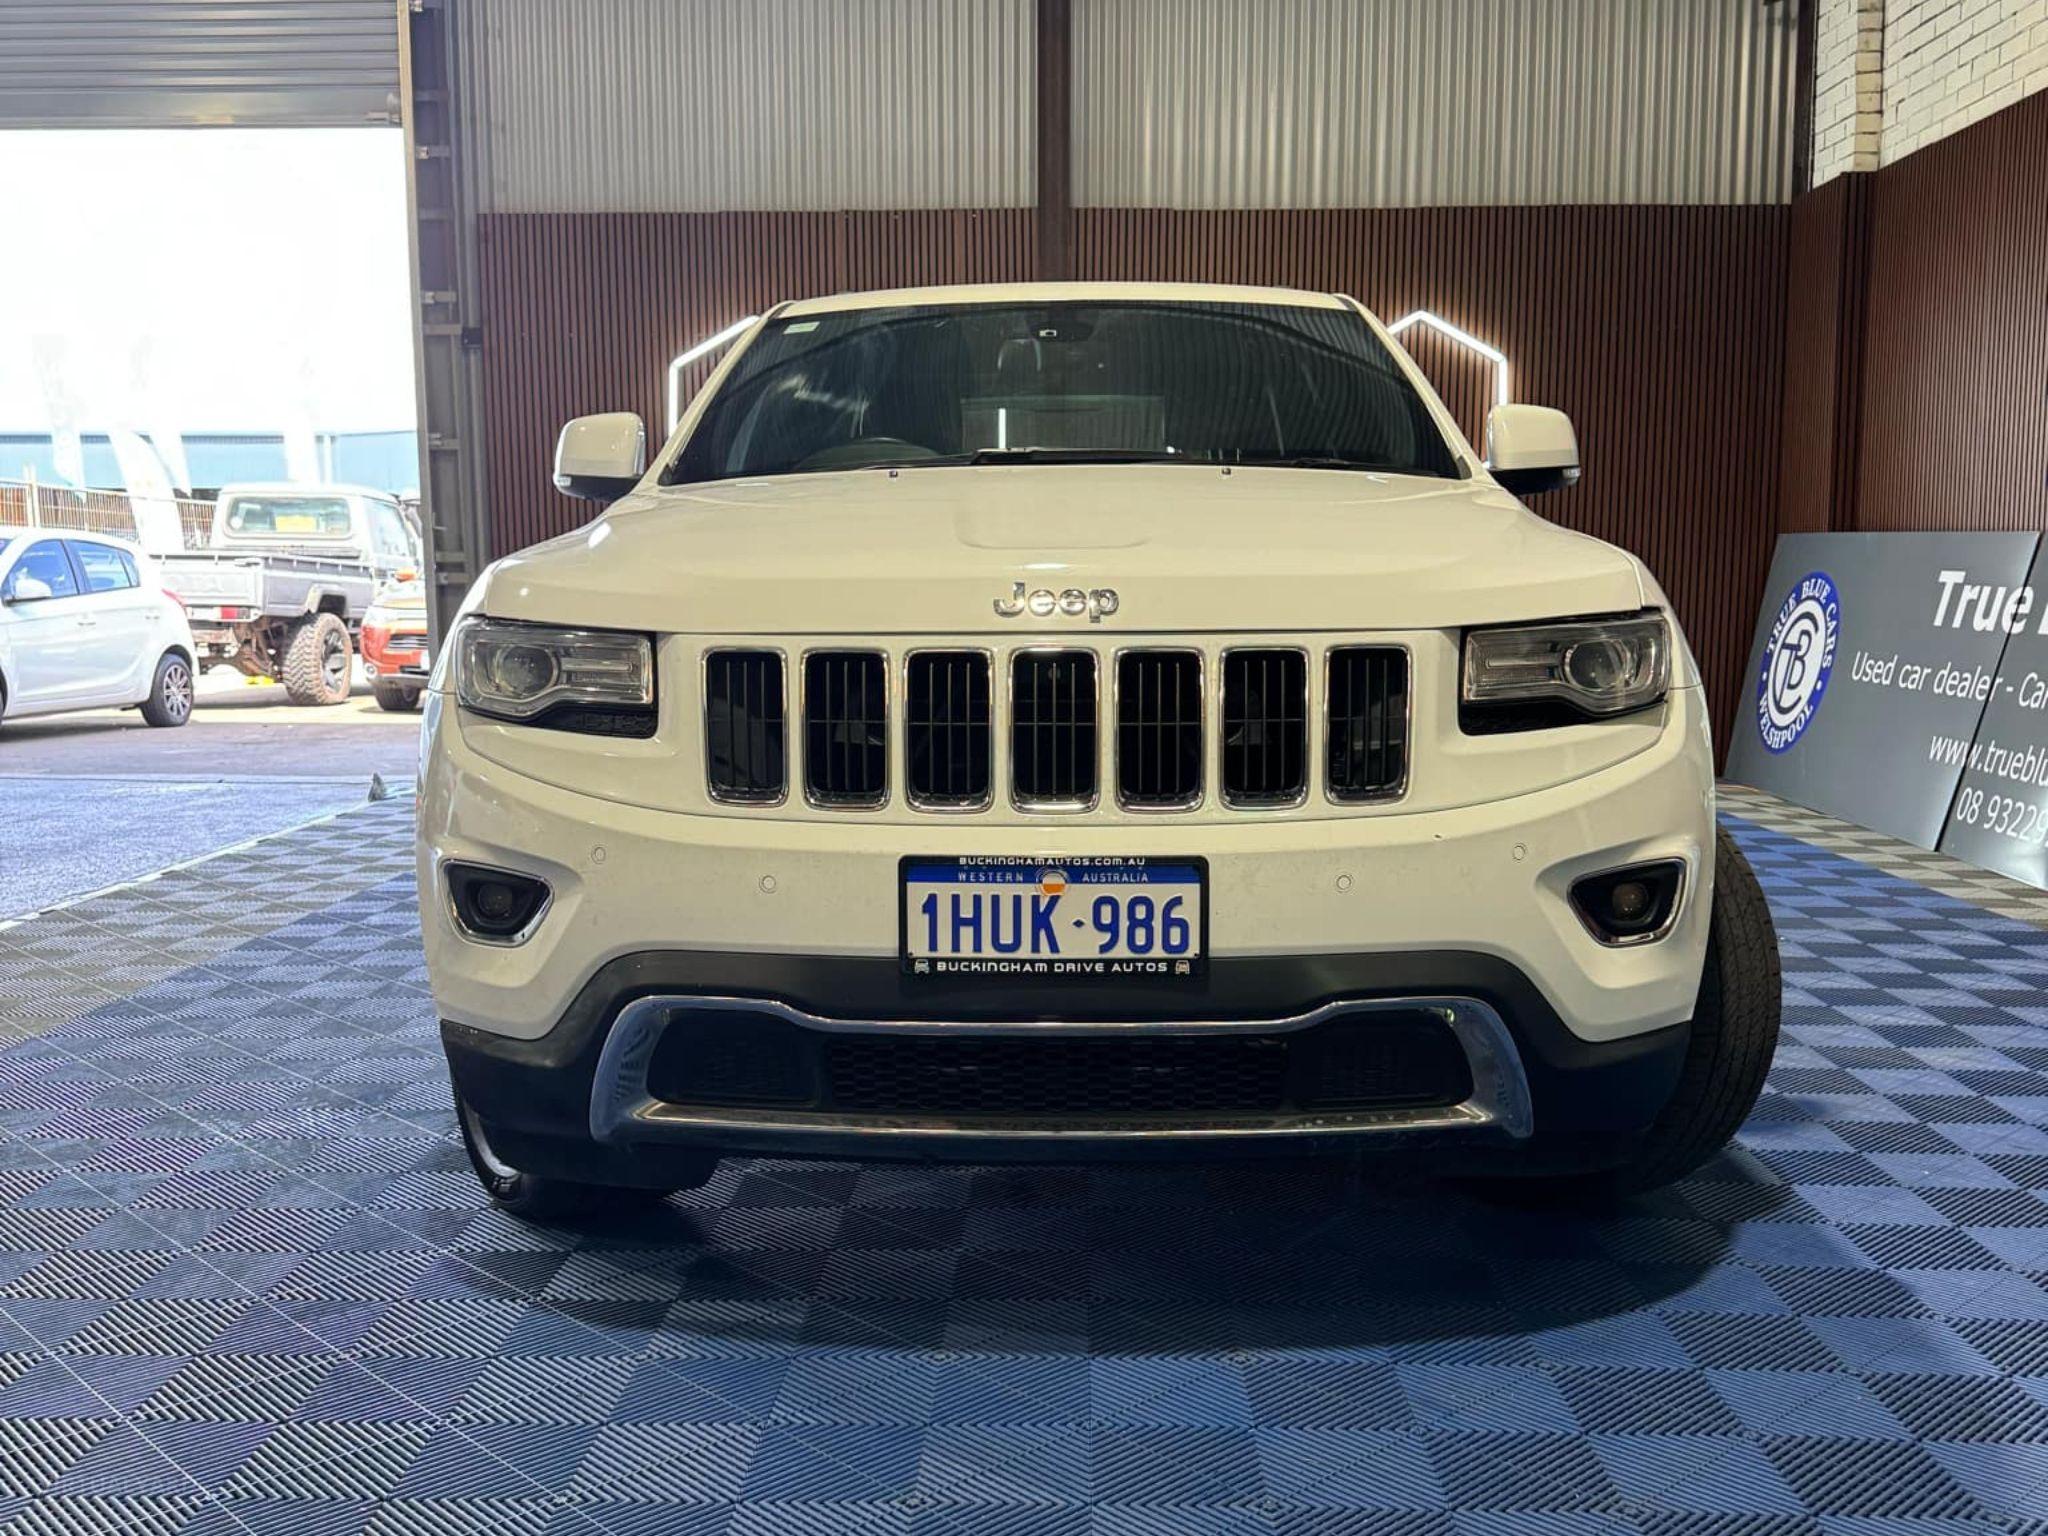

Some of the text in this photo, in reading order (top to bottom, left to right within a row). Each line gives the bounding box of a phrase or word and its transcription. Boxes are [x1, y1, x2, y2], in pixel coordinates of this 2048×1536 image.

[993, 580, 1120, 623] Jeep
[1766, 577, 1838, 669] TRUE BLUE CARS
[1933, 570, 2034, 635] True
[1851, 650, 1898, 686] Used
[1898, 663, 1931, 691] car
[1933, 661, 2003, 702] dealer
[1759, 692, 1814, 749] WELSHPOOL
[1956, 787, 2048, 848] 08 93229
[958, 871, 1149, 883] WESTERN AUSTRALIA
[936, 961, 1168, 973] BUCKINGHAM DRIVE AUTOS
